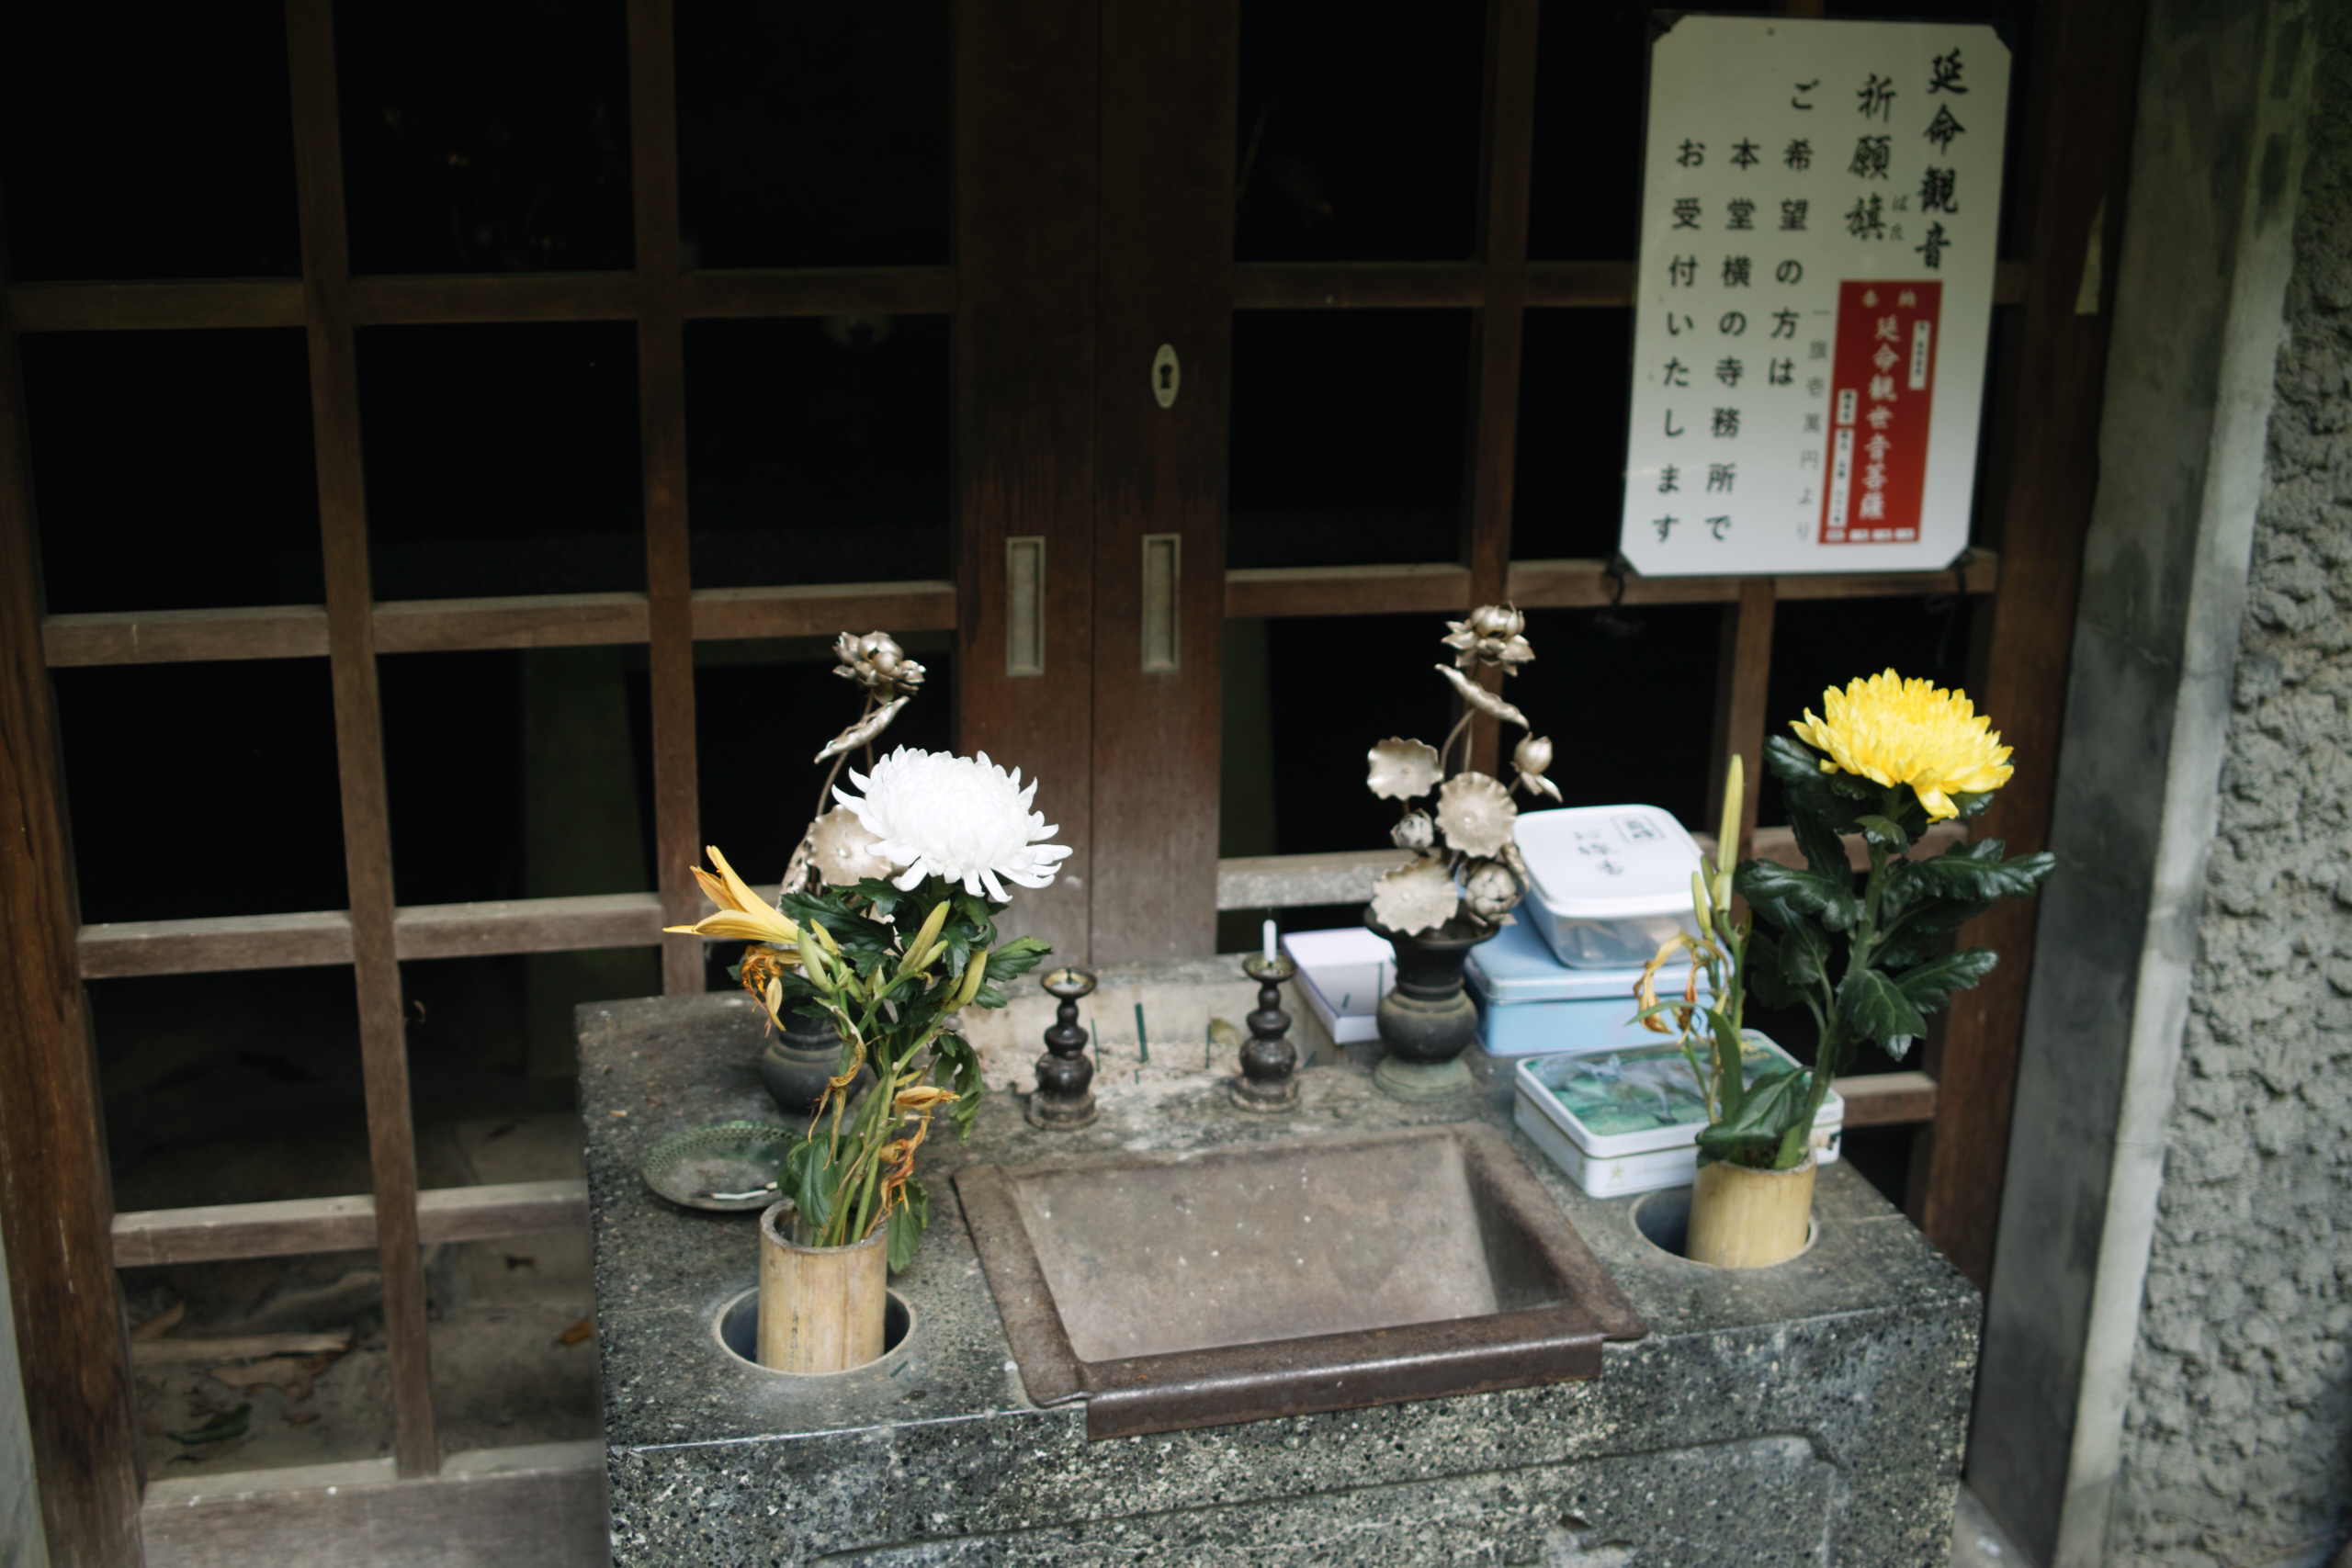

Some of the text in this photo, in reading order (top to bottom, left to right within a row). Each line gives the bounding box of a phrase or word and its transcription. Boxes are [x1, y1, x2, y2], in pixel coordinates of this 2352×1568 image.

[1768, 79, 1820, 387] ご希望の方は
[1844, 73, 1897, 241] 祈願旗
[1652, 139, 1706, 543] お受付いたします
[1705, 137, 1761, 542] 本堂横の寺務所で
